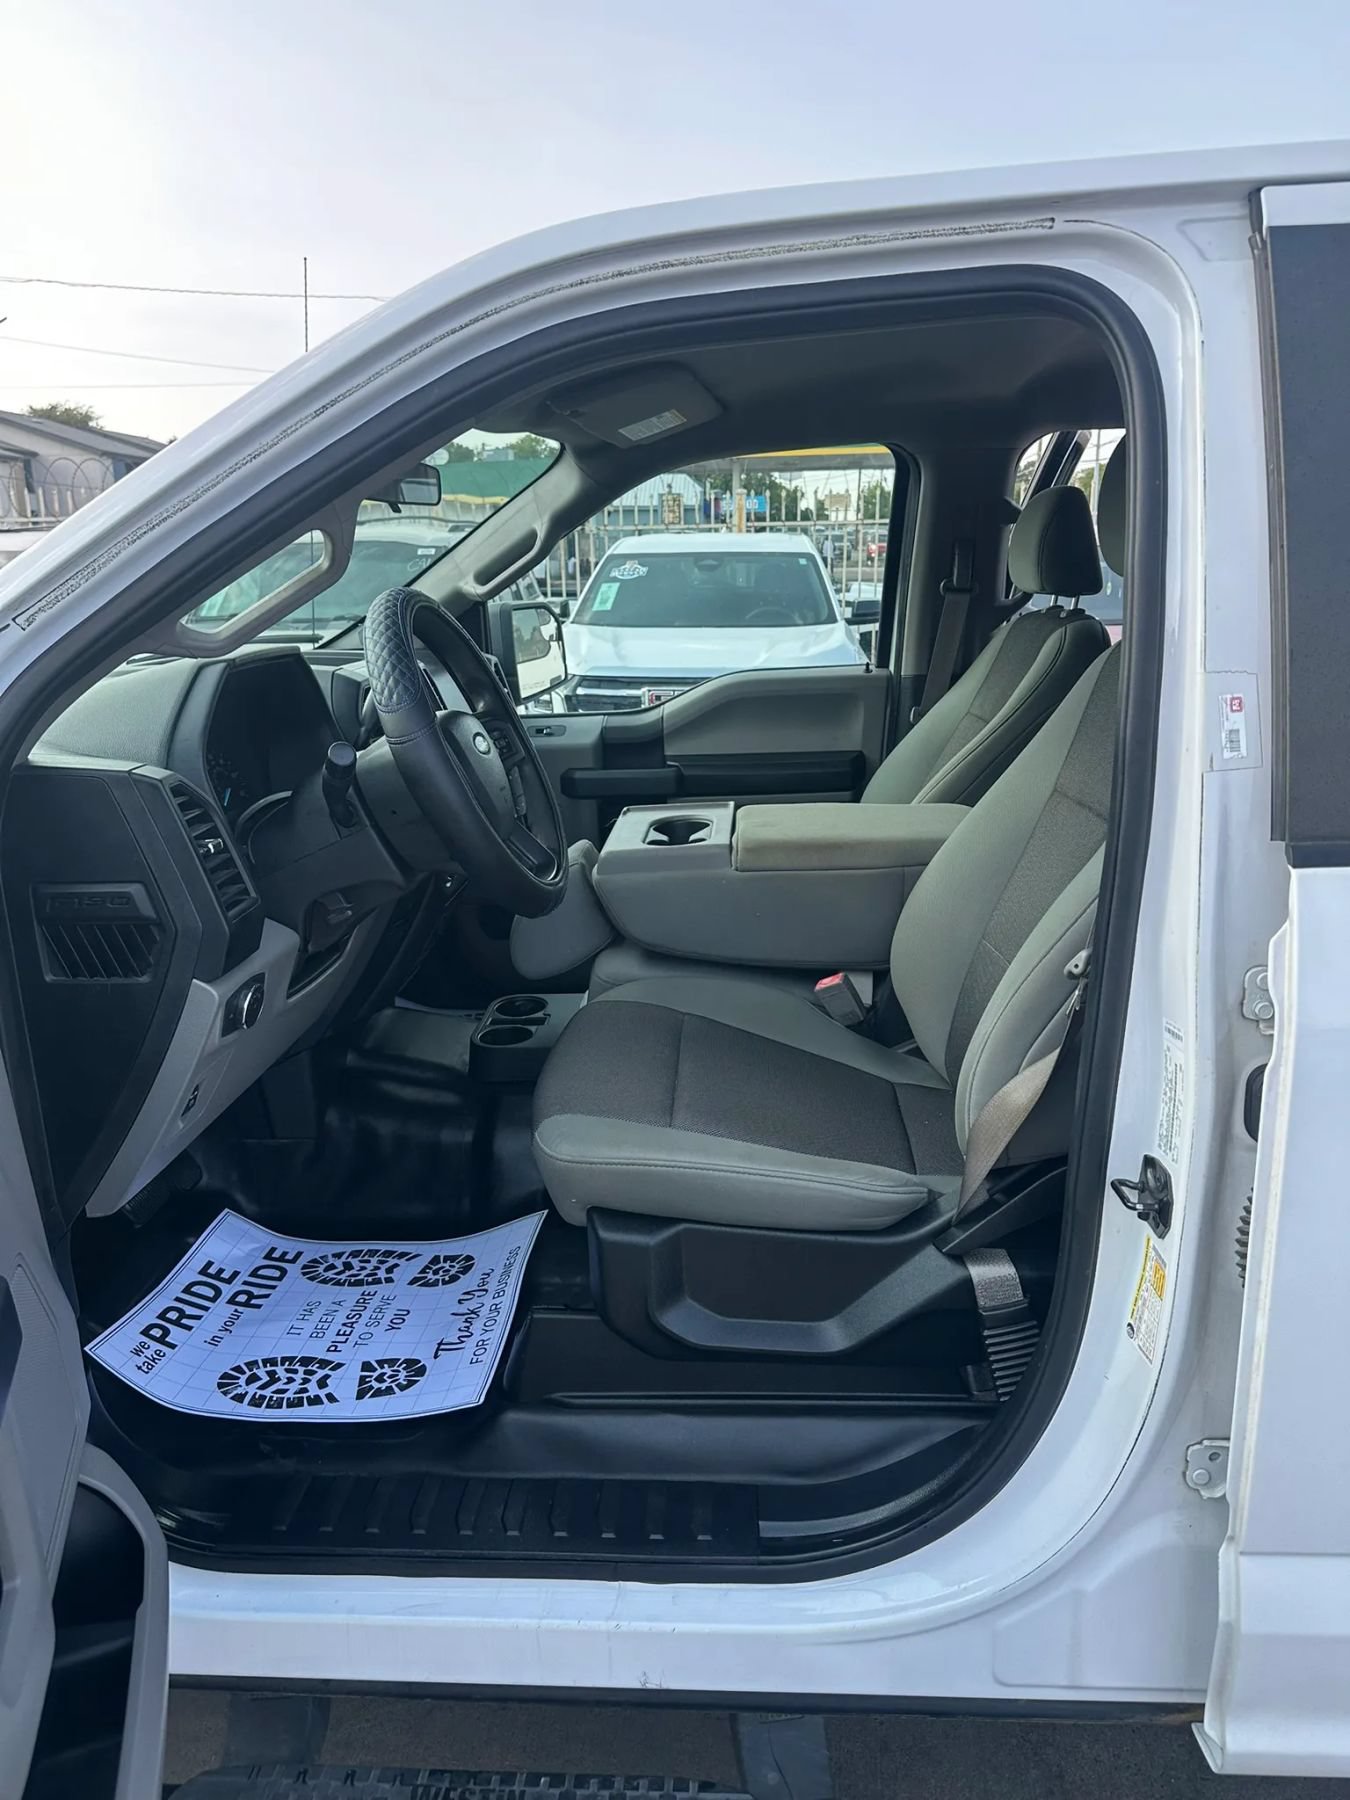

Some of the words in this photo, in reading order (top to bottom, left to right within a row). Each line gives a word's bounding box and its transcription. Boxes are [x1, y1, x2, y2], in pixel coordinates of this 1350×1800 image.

[226, 1246, 304, 1309] RIDE
[457, 1268, 495, 1305] You
[139, 1260, 242, 1351] PRIDE
[221, 1308, 245, 1335] your
[286, 1324, 304, 1336] IT
[296, 1300, 322, 1321] HAS
[309, 1309, 339, 1339] BEEN
[331, 1299, 347, 1307] A
[326, 1290, 378, 1353] PLEASURE
[353, 1332, 374, 1348] TO
[365, 1294, 397, 1328] SERVE
[384, 1308, 411, 1332] YOU
[469, 1337, 491, 1365] FOR
[480, 1301, 503, 1336] YOUR
[492, 1245, 521, 1300] BUSINESS
[130, 1341, 150, 1358] we
[204, 1334, 225, 1347] in
[433, 1302, 485, 1360] Thank
[136, 1348, 167, 1375] take
